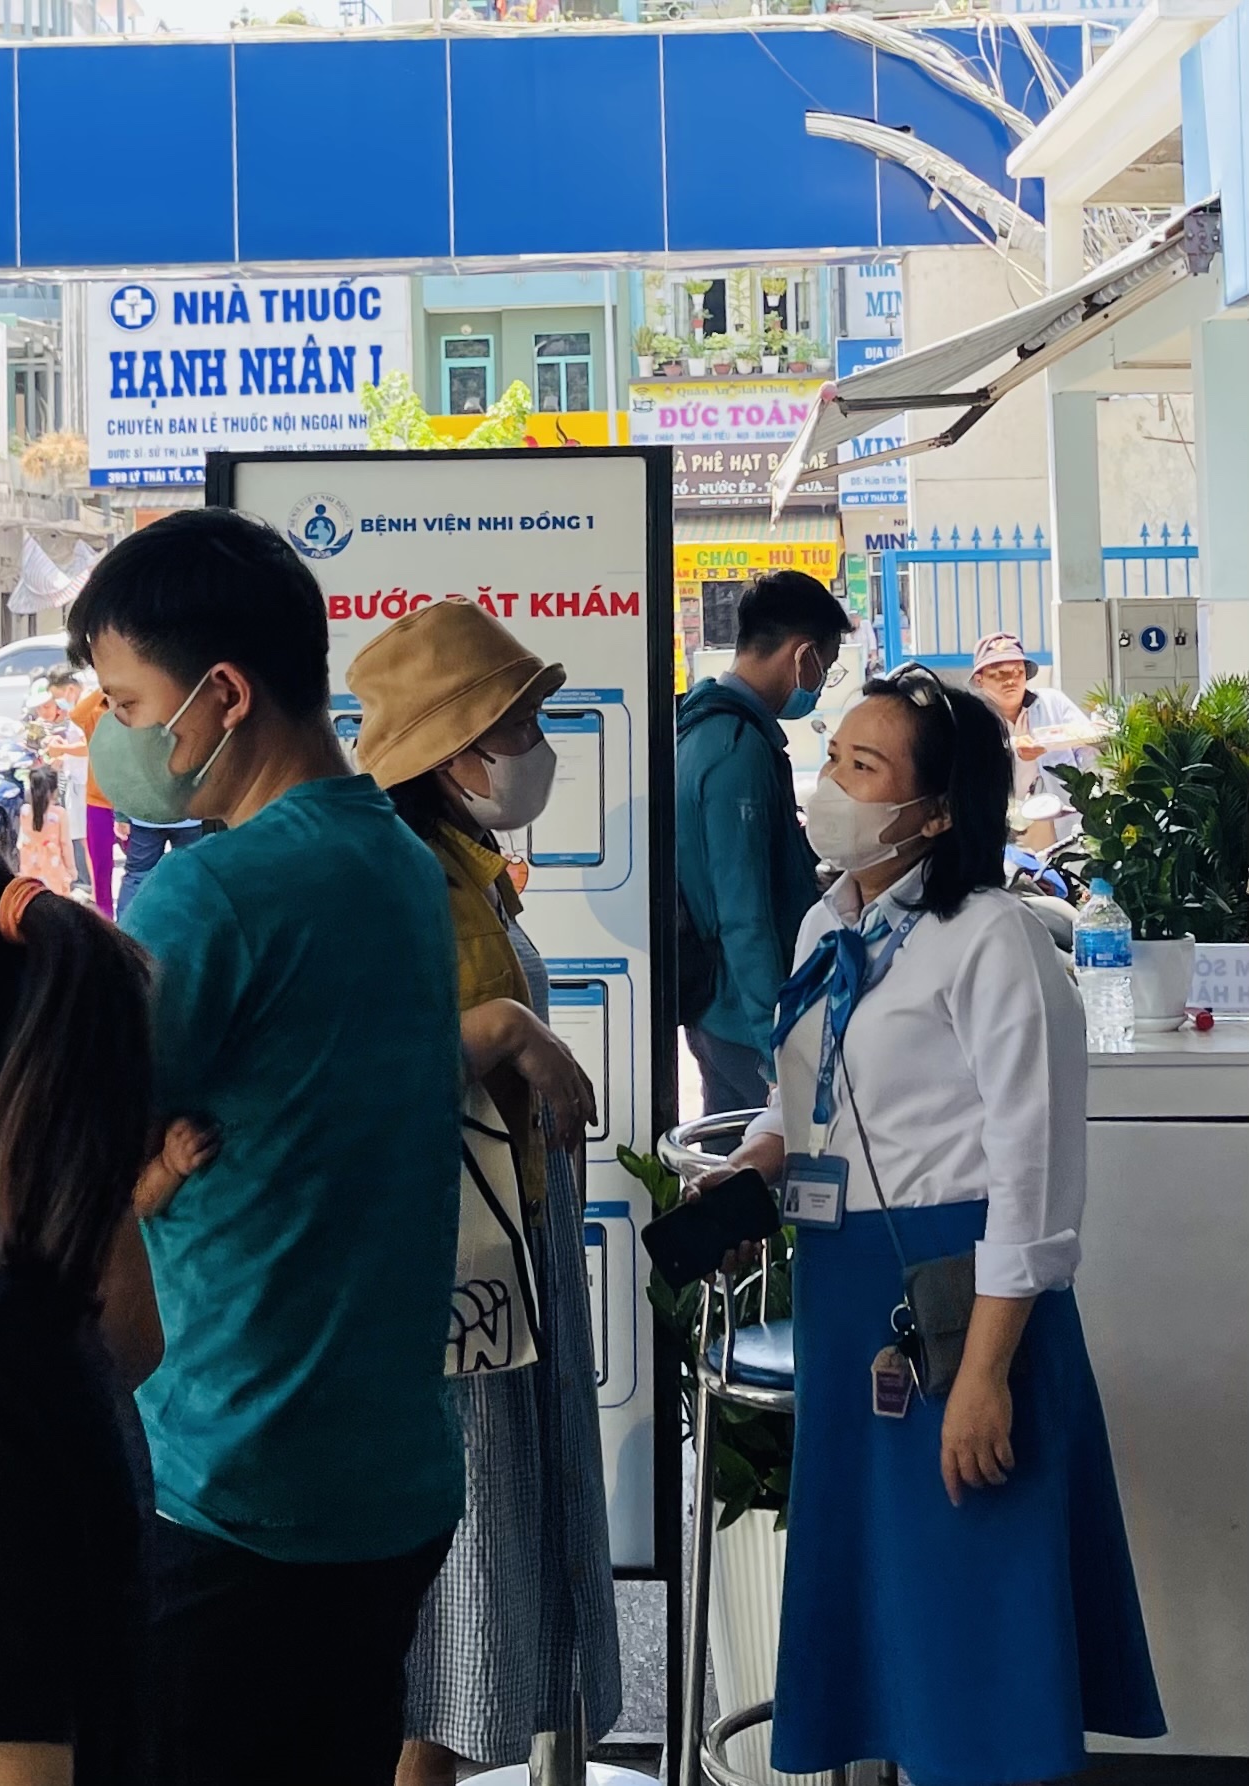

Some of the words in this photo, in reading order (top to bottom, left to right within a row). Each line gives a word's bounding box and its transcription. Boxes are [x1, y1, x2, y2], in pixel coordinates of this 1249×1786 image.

[173, 281, 251, 326] NHÀ
[260, 277, 383, 323] THUỐC
[109, 348, 228, 409] HẠNH
[239, 333, 356, 397] NHÂN
[107, 413, 164, 436] CHUYÊN
[168, 414, 198, 435] BÁN
[202, 410, 219, 434] LẺ
[223, 411, 269, 433] THUỐC
[273, 412, 297, 437] NỘI
[301, 412, 344, 437] NGOẠI
[658, 400, 720, 429] ĐỨC
[691, 450, 725, 475] PHÊ
[730, 452, 762, 477] HẠT
[698, 478, 737, 495] NƯỚC
[739, 478, 757, 495] ÉP
[360, 513, 417, 537] BỆNH
[423, 512, 471, 536] VIỆN
[478, 515, 513, 531] NHI
[519, 509, 581, 531] ĐỒNG
[586, 515, 595, 530] 1
[696, 546, 749, 567] CHÁO
[768, 544, 795, 566] HỦ
[529, 583, 640, 619] KHÁM
[1148, 630, 1159, 648] 1
